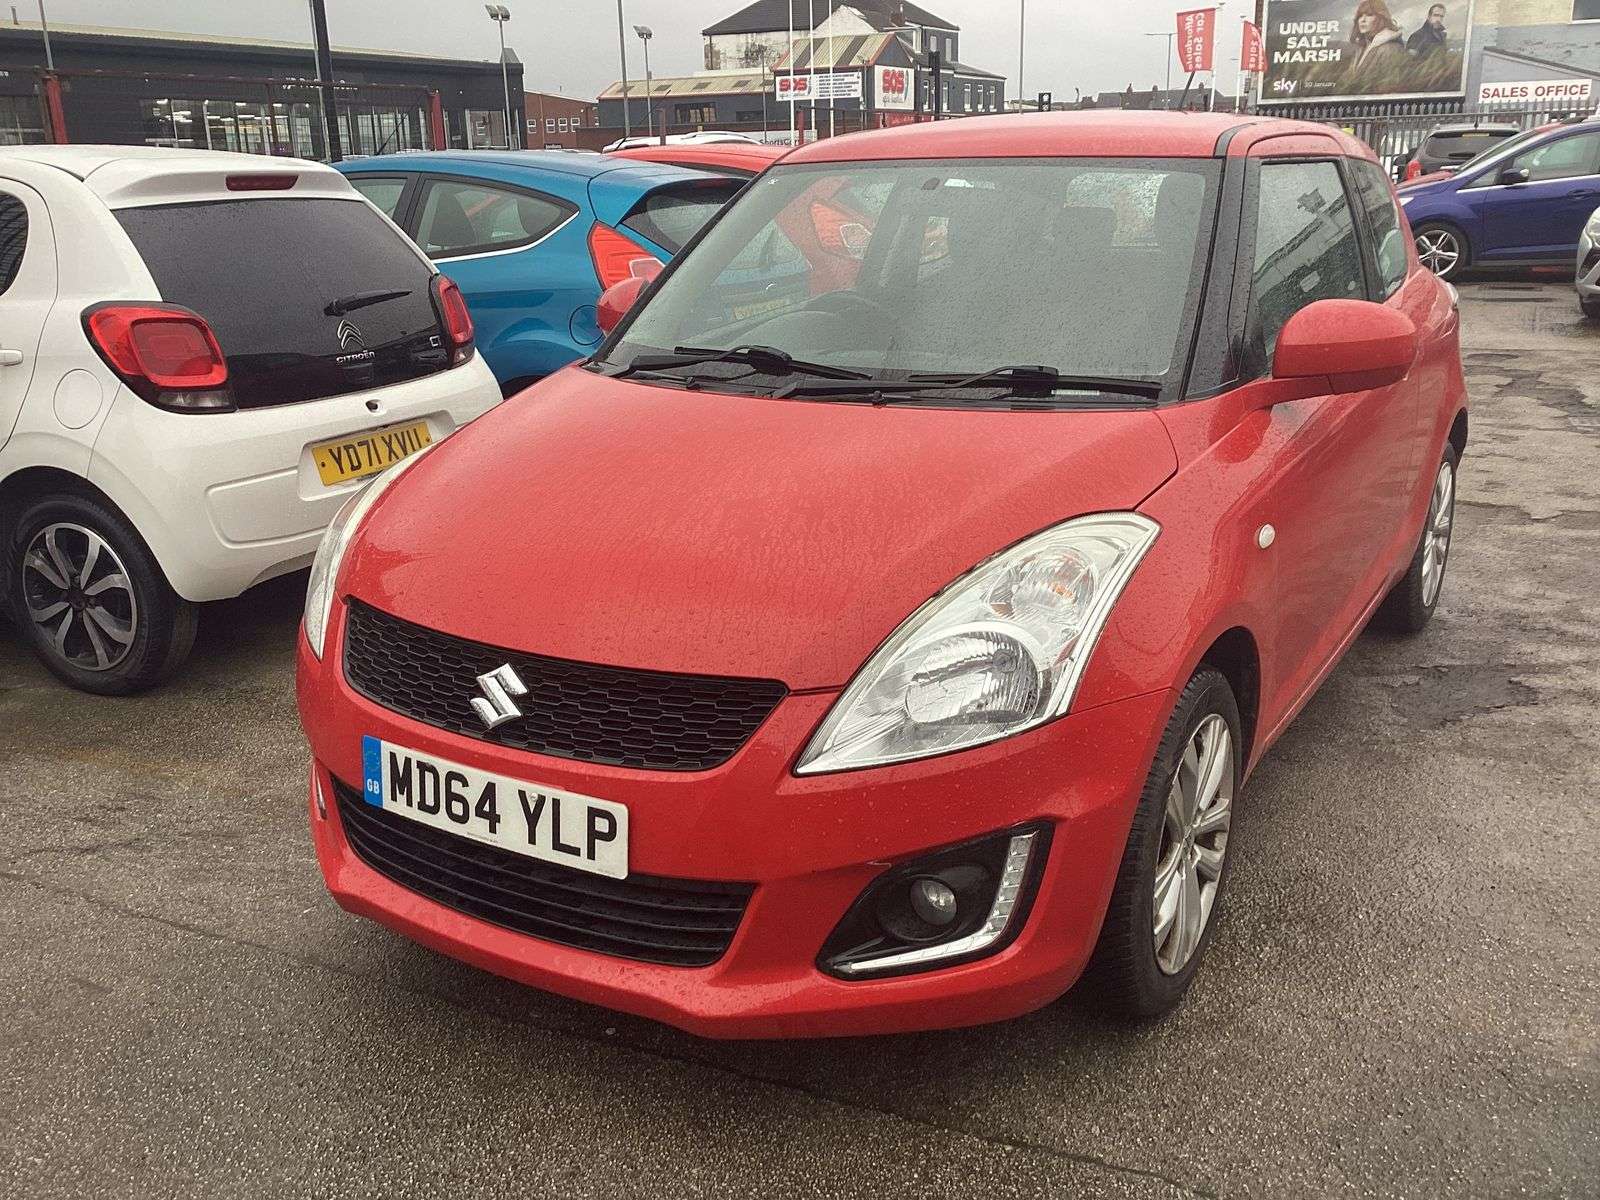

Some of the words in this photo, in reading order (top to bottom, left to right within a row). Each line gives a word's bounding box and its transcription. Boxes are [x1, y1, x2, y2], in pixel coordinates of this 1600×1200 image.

[1280, 21, 1340, 35] UNDER
[1287, 35, 1331, 49] SALT
[1273, 49, 1342, 64] MARSH
[882, 69, 905, 94] SOS
[1273, 77, 1297, 93] sky
[1482, 86, 1529, 98] SALES
[1535, 84, 1589, 96] OFFICE
[328, 439, 383, 475] YD71
[366, 778, 380, 794] GB
[389, 750, 501, 835] MD64
[518, 788, 618, 861] YLP
